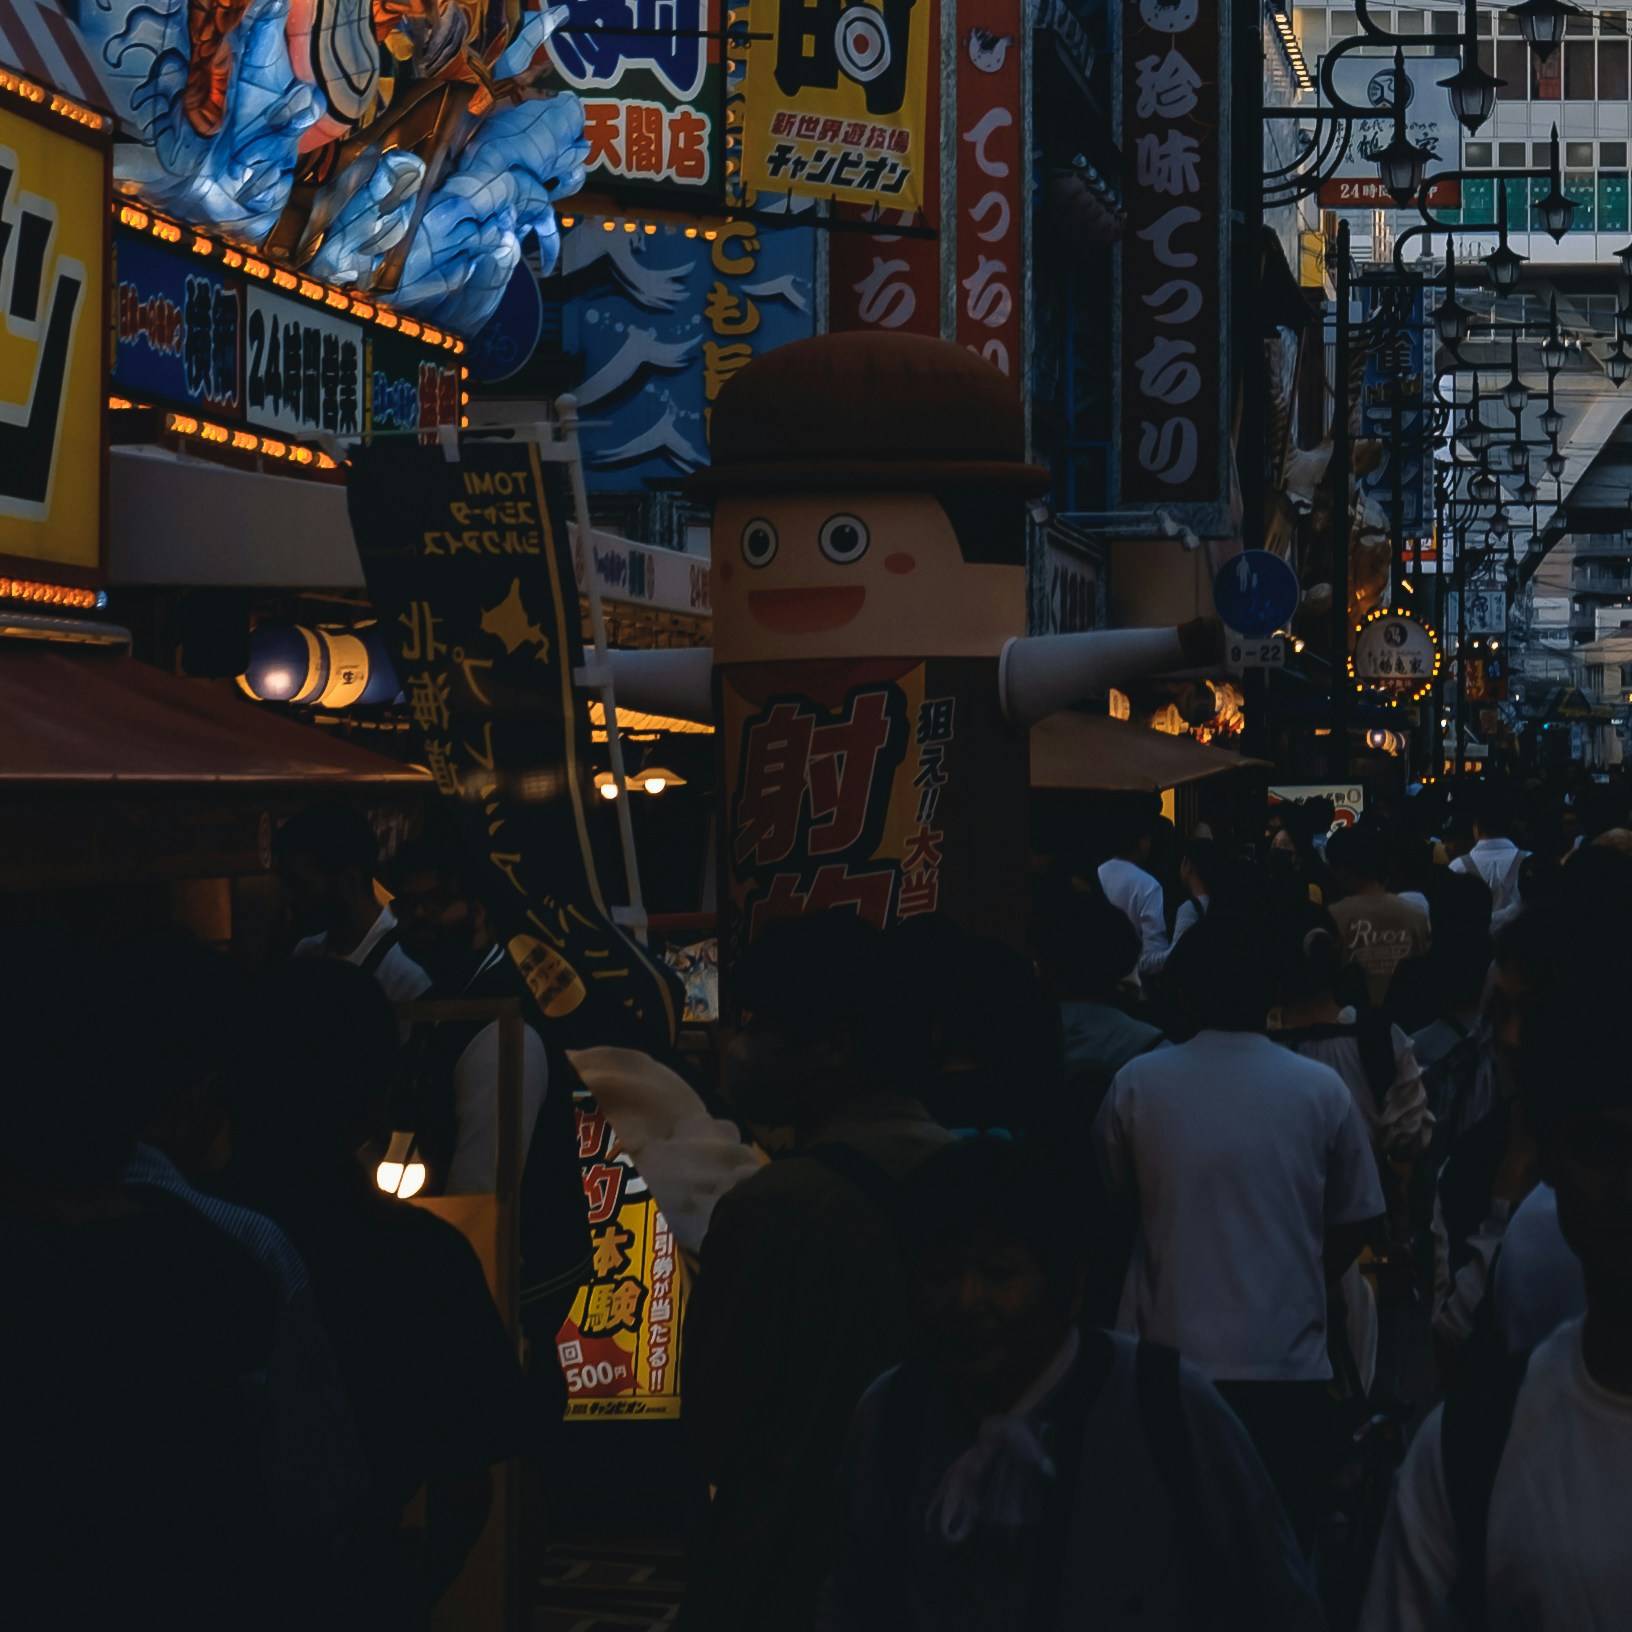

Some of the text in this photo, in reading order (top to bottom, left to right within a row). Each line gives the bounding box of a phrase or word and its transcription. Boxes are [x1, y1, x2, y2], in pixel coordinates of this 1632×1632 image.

[771, 111, 911, 154] 新世界遊技場
[766, 143, 912, 193] チャンピオン
[1134, 46, 1204, 486] 珍味てっちり
[249, 307, 358, 433] 24時間営業
[566, 1361, 627, 1393] 500円
